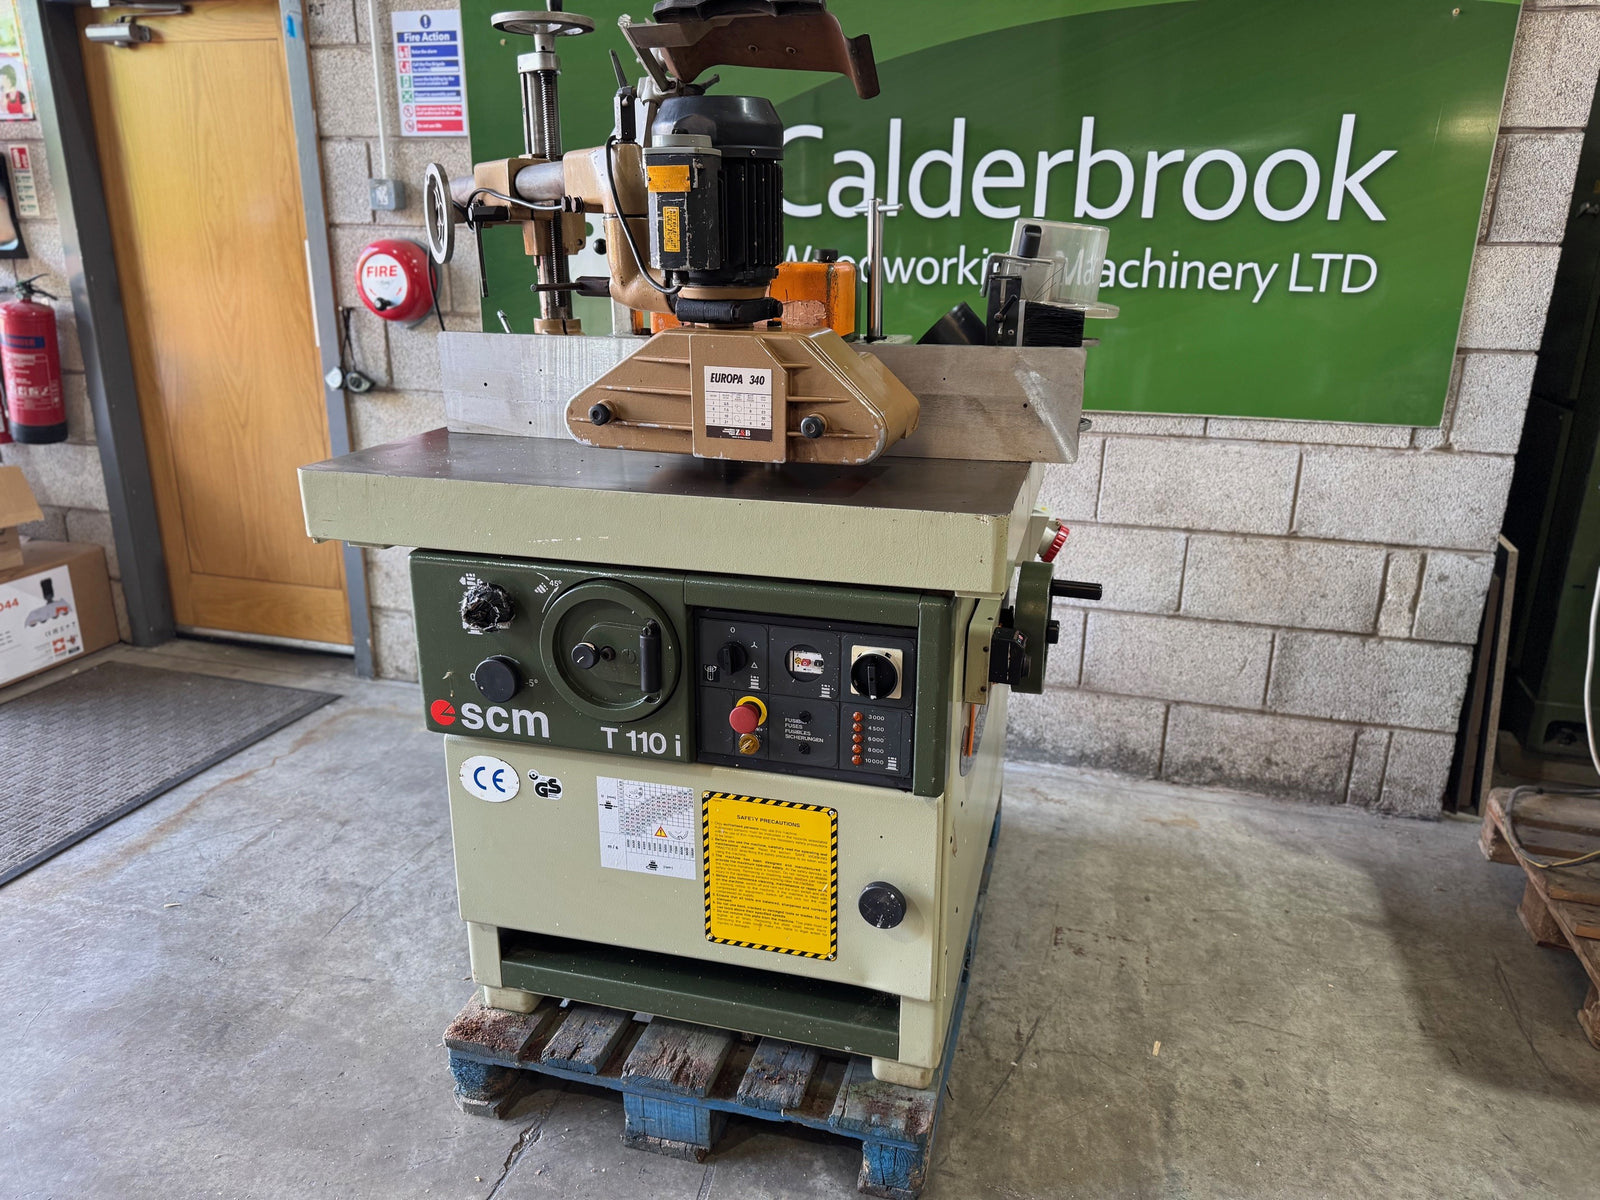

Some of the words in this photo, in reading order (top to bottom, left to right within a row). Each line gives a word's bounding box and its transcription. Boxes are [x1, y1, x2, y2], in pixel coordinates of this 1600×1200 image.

[404, 32, 420, 42] Fire
[422, 32, 450, 42] Action
[783, 113, 1399, 222] Calderbrook
[367, 266, 398, 278] FIRE
[1288, 252, 1378, 294] LTD
[710, 373, 743, 384] EUROPA
[749, 375, 765, 385] 340
[461, 702, 550, 738] scm
[600, 726, 618, 748] T
[626, 730, 667, 755] 110
[674, 734, 681, 756] i
[473, 766, 506, 793] CE
[535, 778, 562, 798] GS
[737, 815, 759, 823] SAFETY
[760, 818, 800, 828] PRECAUTIONS
